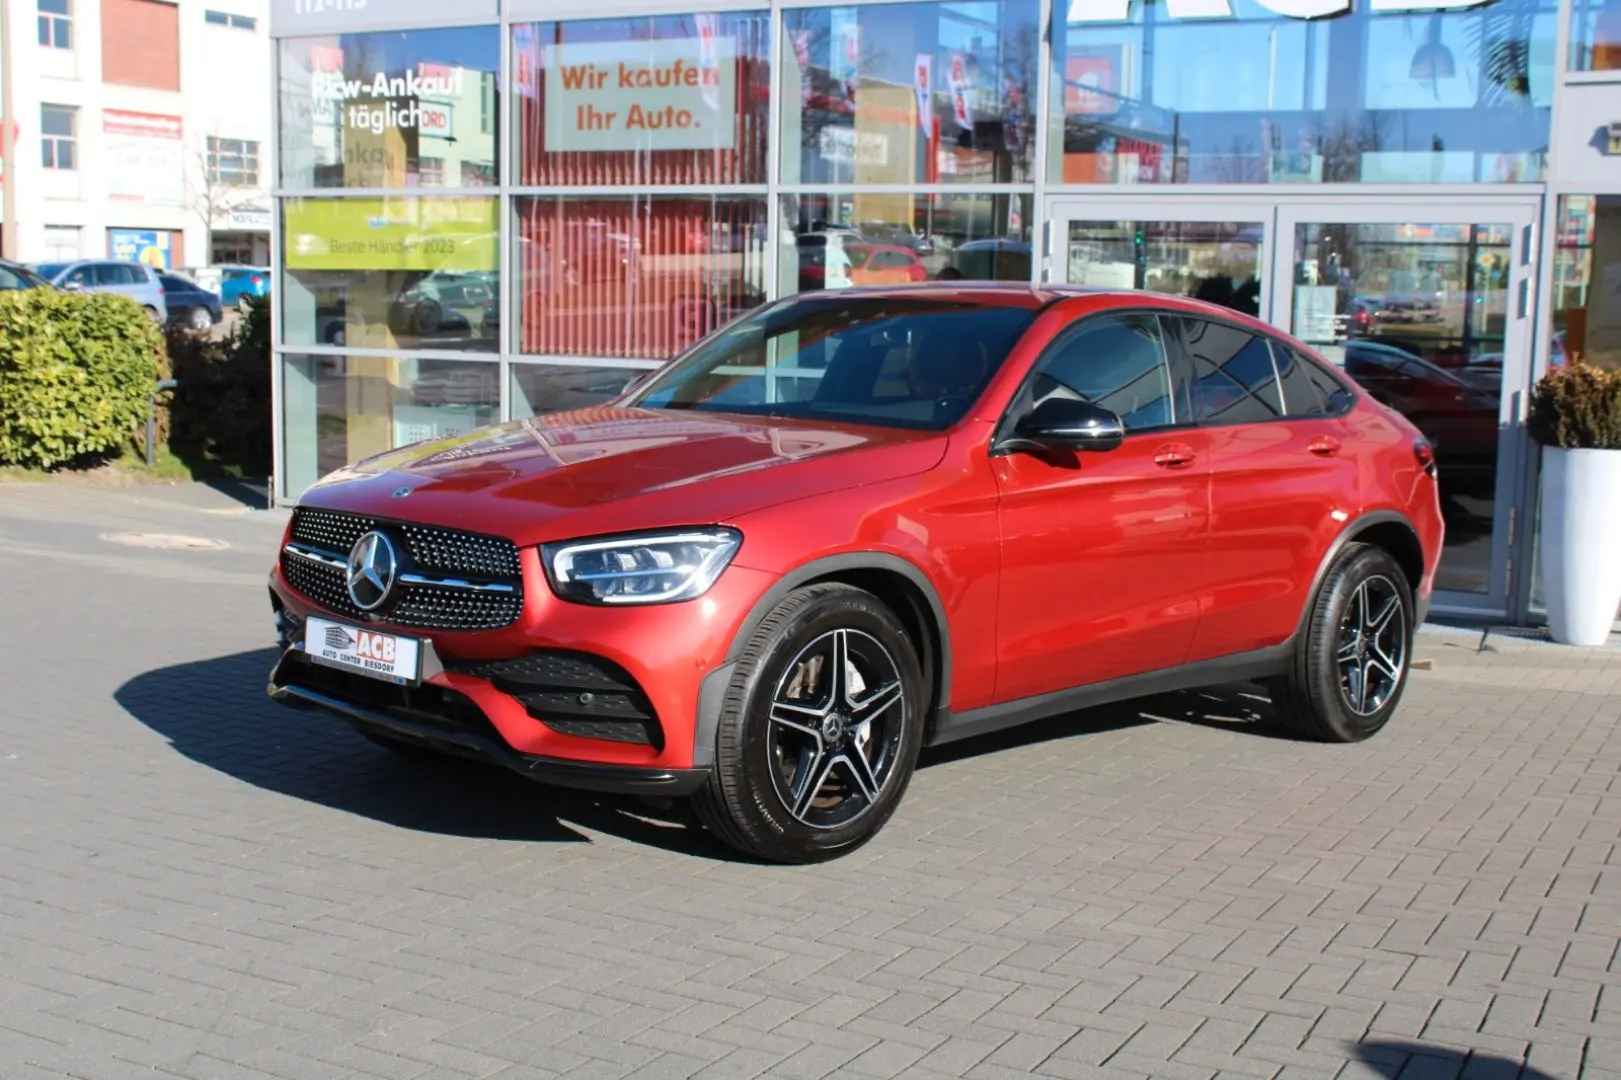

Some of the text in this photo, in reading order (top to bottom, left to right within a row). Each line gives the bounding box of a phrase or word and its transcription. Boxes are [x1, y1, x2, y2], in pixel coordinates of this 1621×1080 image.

[561, 59, 720, 90] Wir kaufen
[349, 101, 423, 134] täglich
[576, 104, 701, 131] Ihr Auto.
[330, 239, 366, 253] Beste
[423, 239, 455, 254] 2023
[322, 649, 394, 673] AUTO CENTER BIESDORF
[357, 631, 396, 662] ACB
